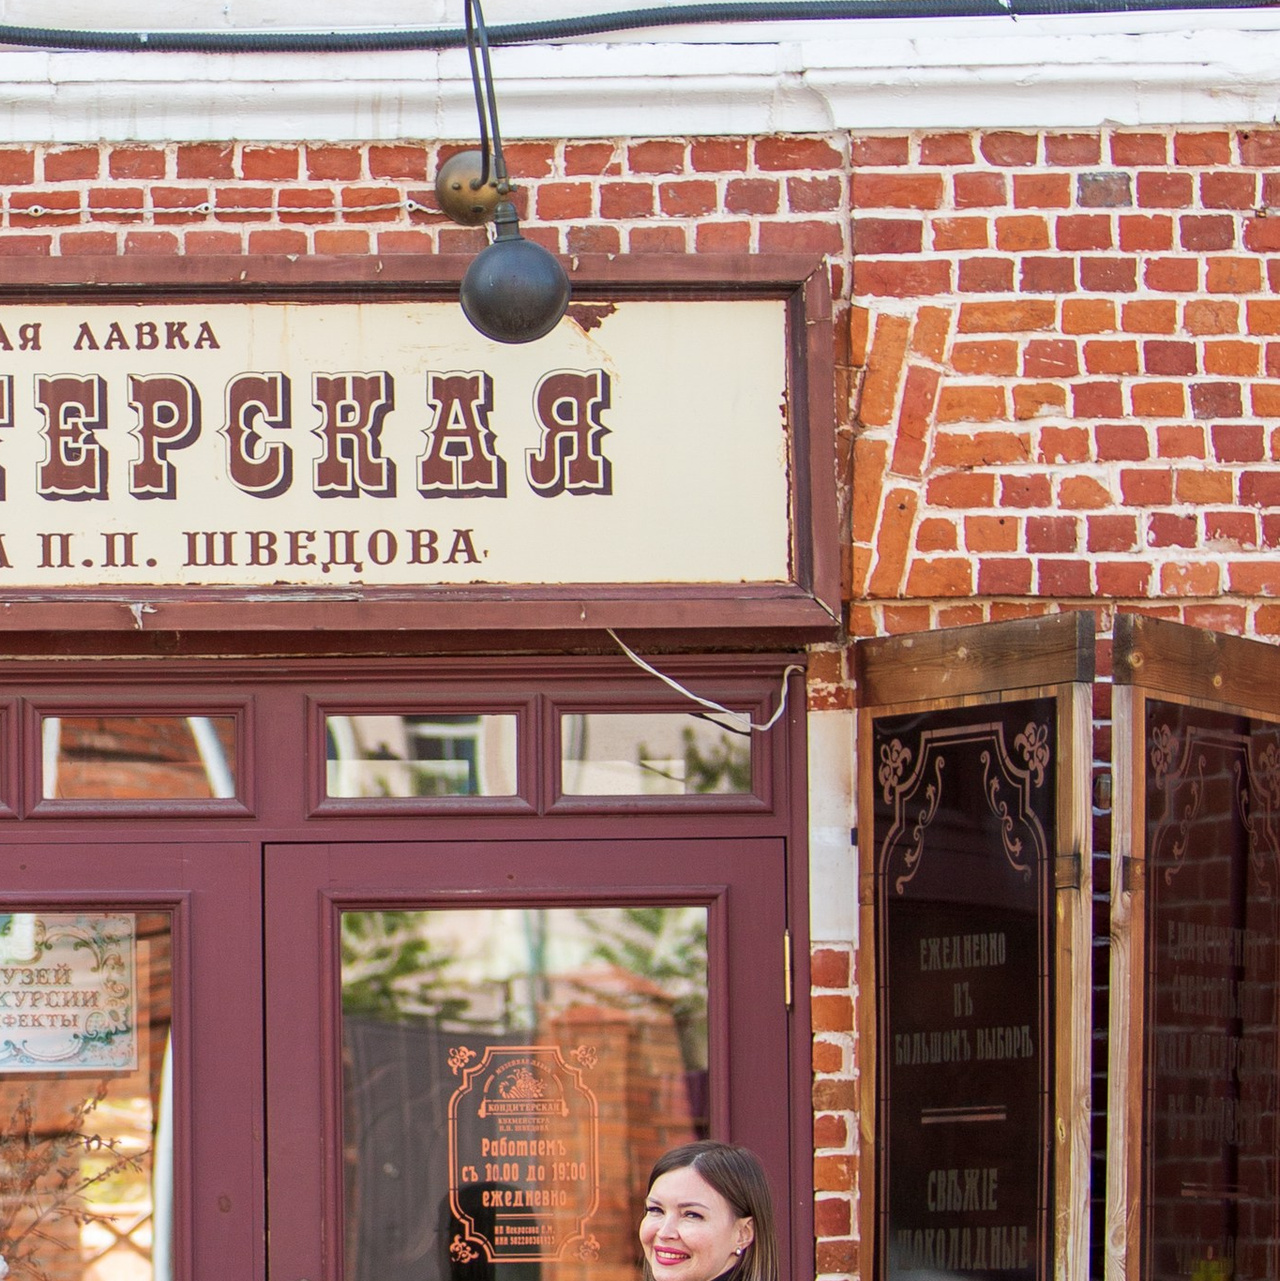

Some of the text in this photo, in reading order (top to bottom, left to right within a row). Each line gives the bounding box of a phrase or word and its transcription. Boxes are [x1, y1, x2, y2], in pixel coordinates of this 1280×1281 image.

[71, 320, 221, 352] ЛАВКА
[36, 531, 158, 570] П.П.
[181, 528, 482, 573] ШВЕДОВА
[919, 932, 1007, 972] ЕЖЕДНЕВНО
[953, 981, 974, 1017] ВЪ
[894, 1029, 971, 1065] БОЛЬШОМЪ
[481, 1137, 567, 1157] Работаемъ
[461, 1165, 479, 1183] съ
[485, 1162, 519, 1183] 10.00
[526, 1164, 545, 1183] до
[482, 1188, 567, 1207] ежедневно
[896, 1226, 1029, 1271] ШОКОЛАДНЫЕ
